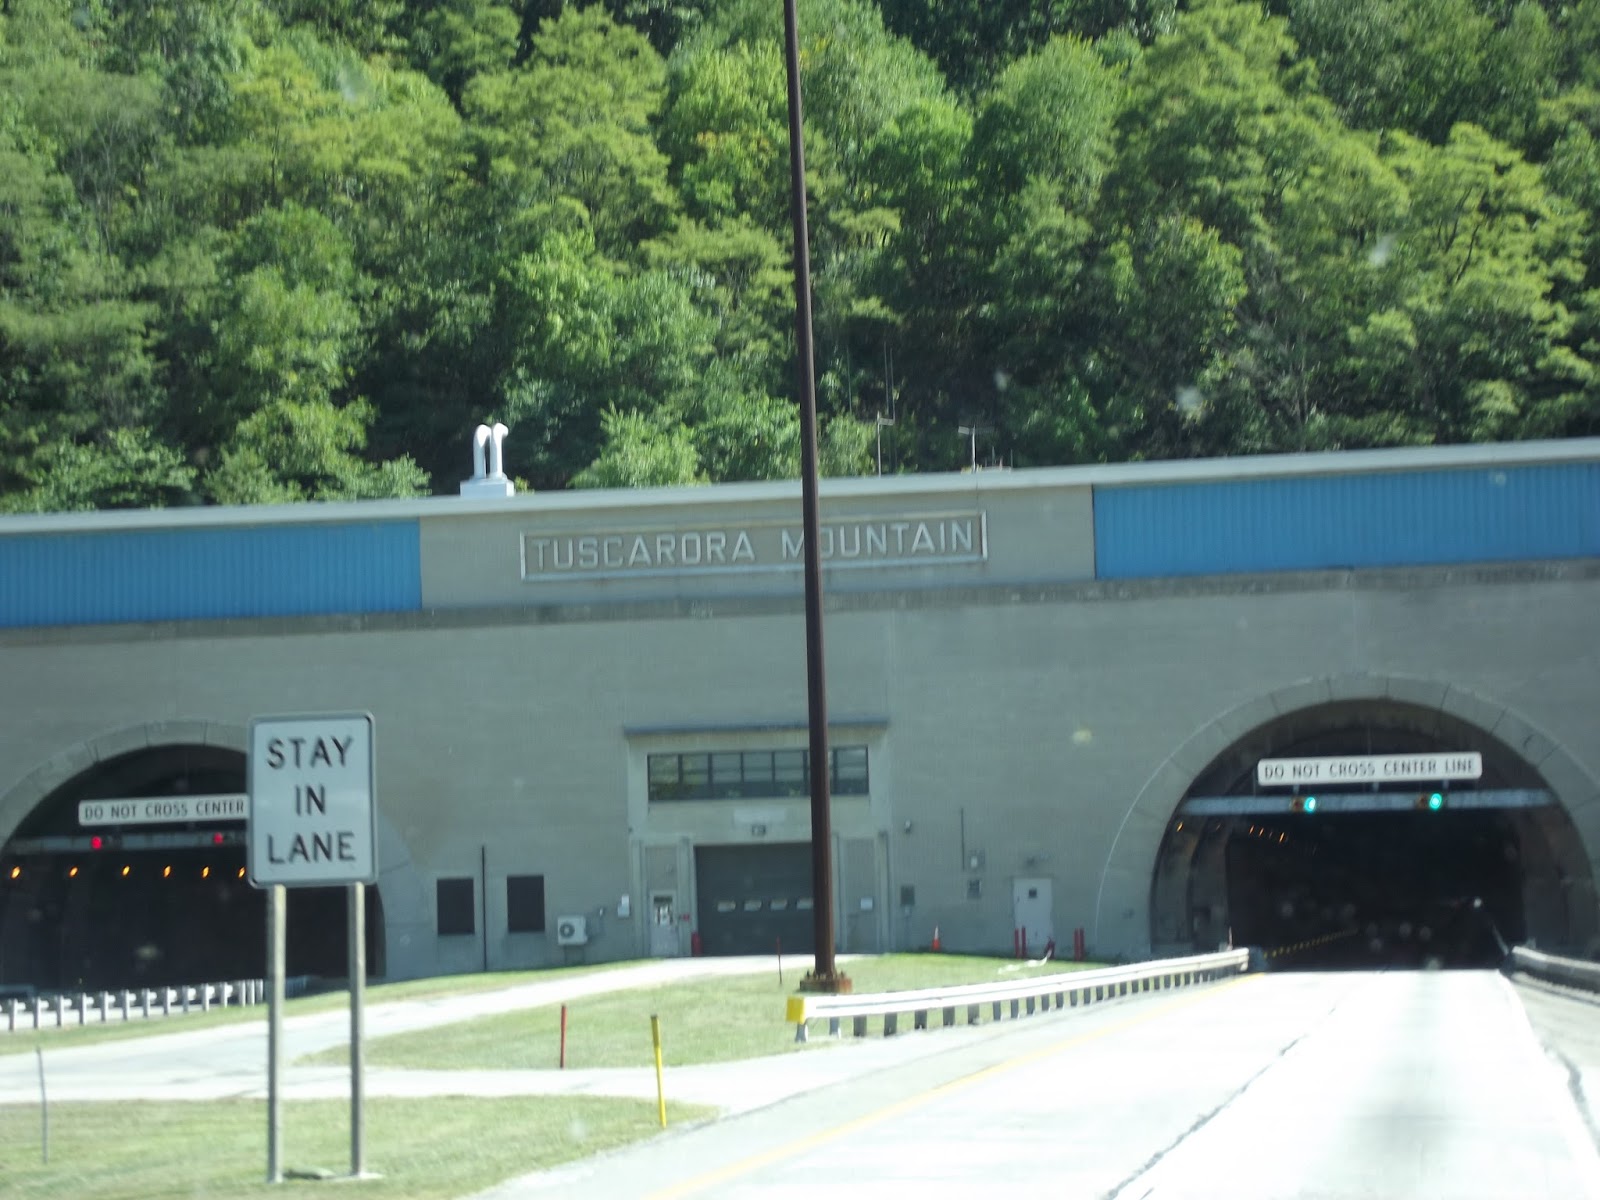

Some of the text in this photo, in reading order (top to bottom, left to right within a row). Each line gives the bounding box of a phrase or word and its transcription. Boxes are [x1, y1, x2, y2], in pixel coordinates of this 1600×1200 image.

[531, 520, 974, 570] TUSCARORA MOUNTAIN
[267, 735, 353, 769] STAY
[1264, 758, 1475, 779] DO NOT CROSS CENTER LINE
[84, 800, 245, 820] DO NOT CROSS CENTER
[295, 784, 326, 816] IN
[267, 832, 356, 865] LANE
